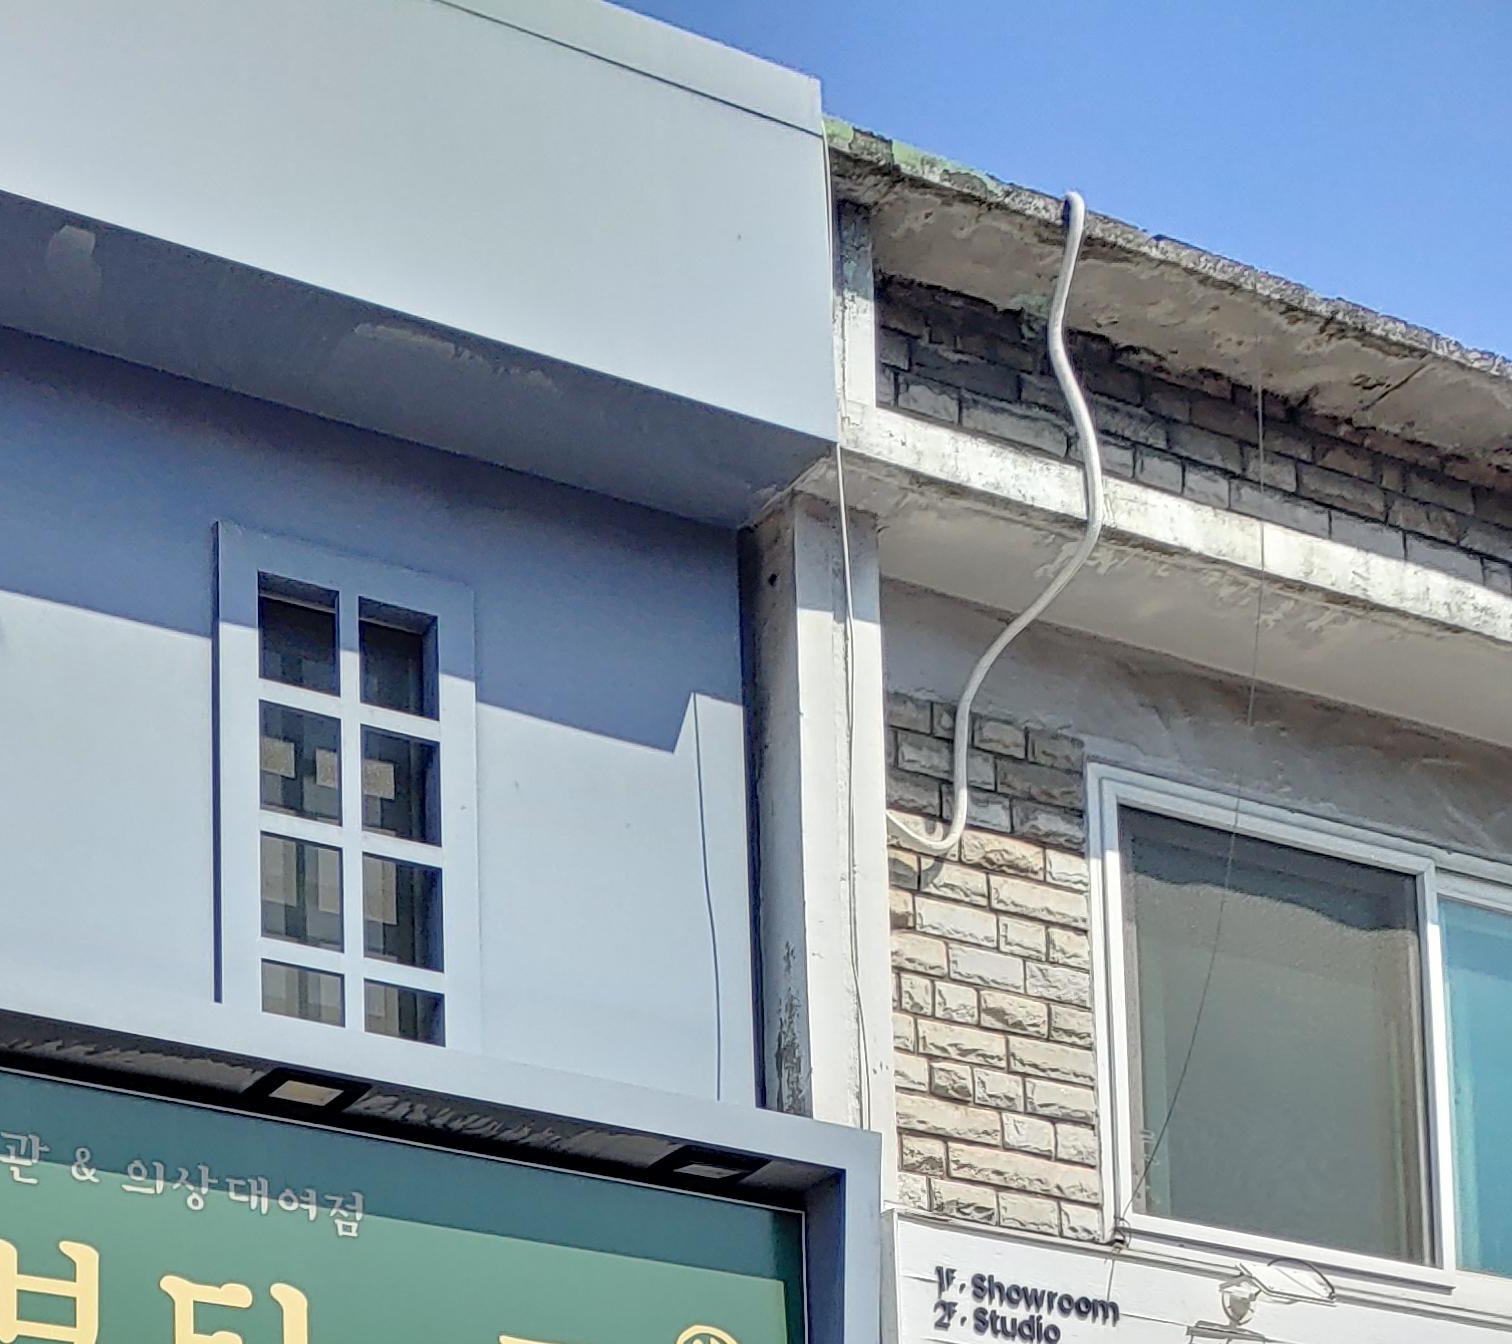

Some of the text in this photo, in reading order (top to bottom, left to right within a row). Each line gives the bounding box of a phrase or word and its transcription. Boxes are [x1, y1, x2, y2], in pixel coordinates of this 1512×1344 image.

[71, 1147, 100, 1184] &
[121, 1159, 365, 1238] 의상대여점
[971, 1273, 1120, 1327] Showroom
